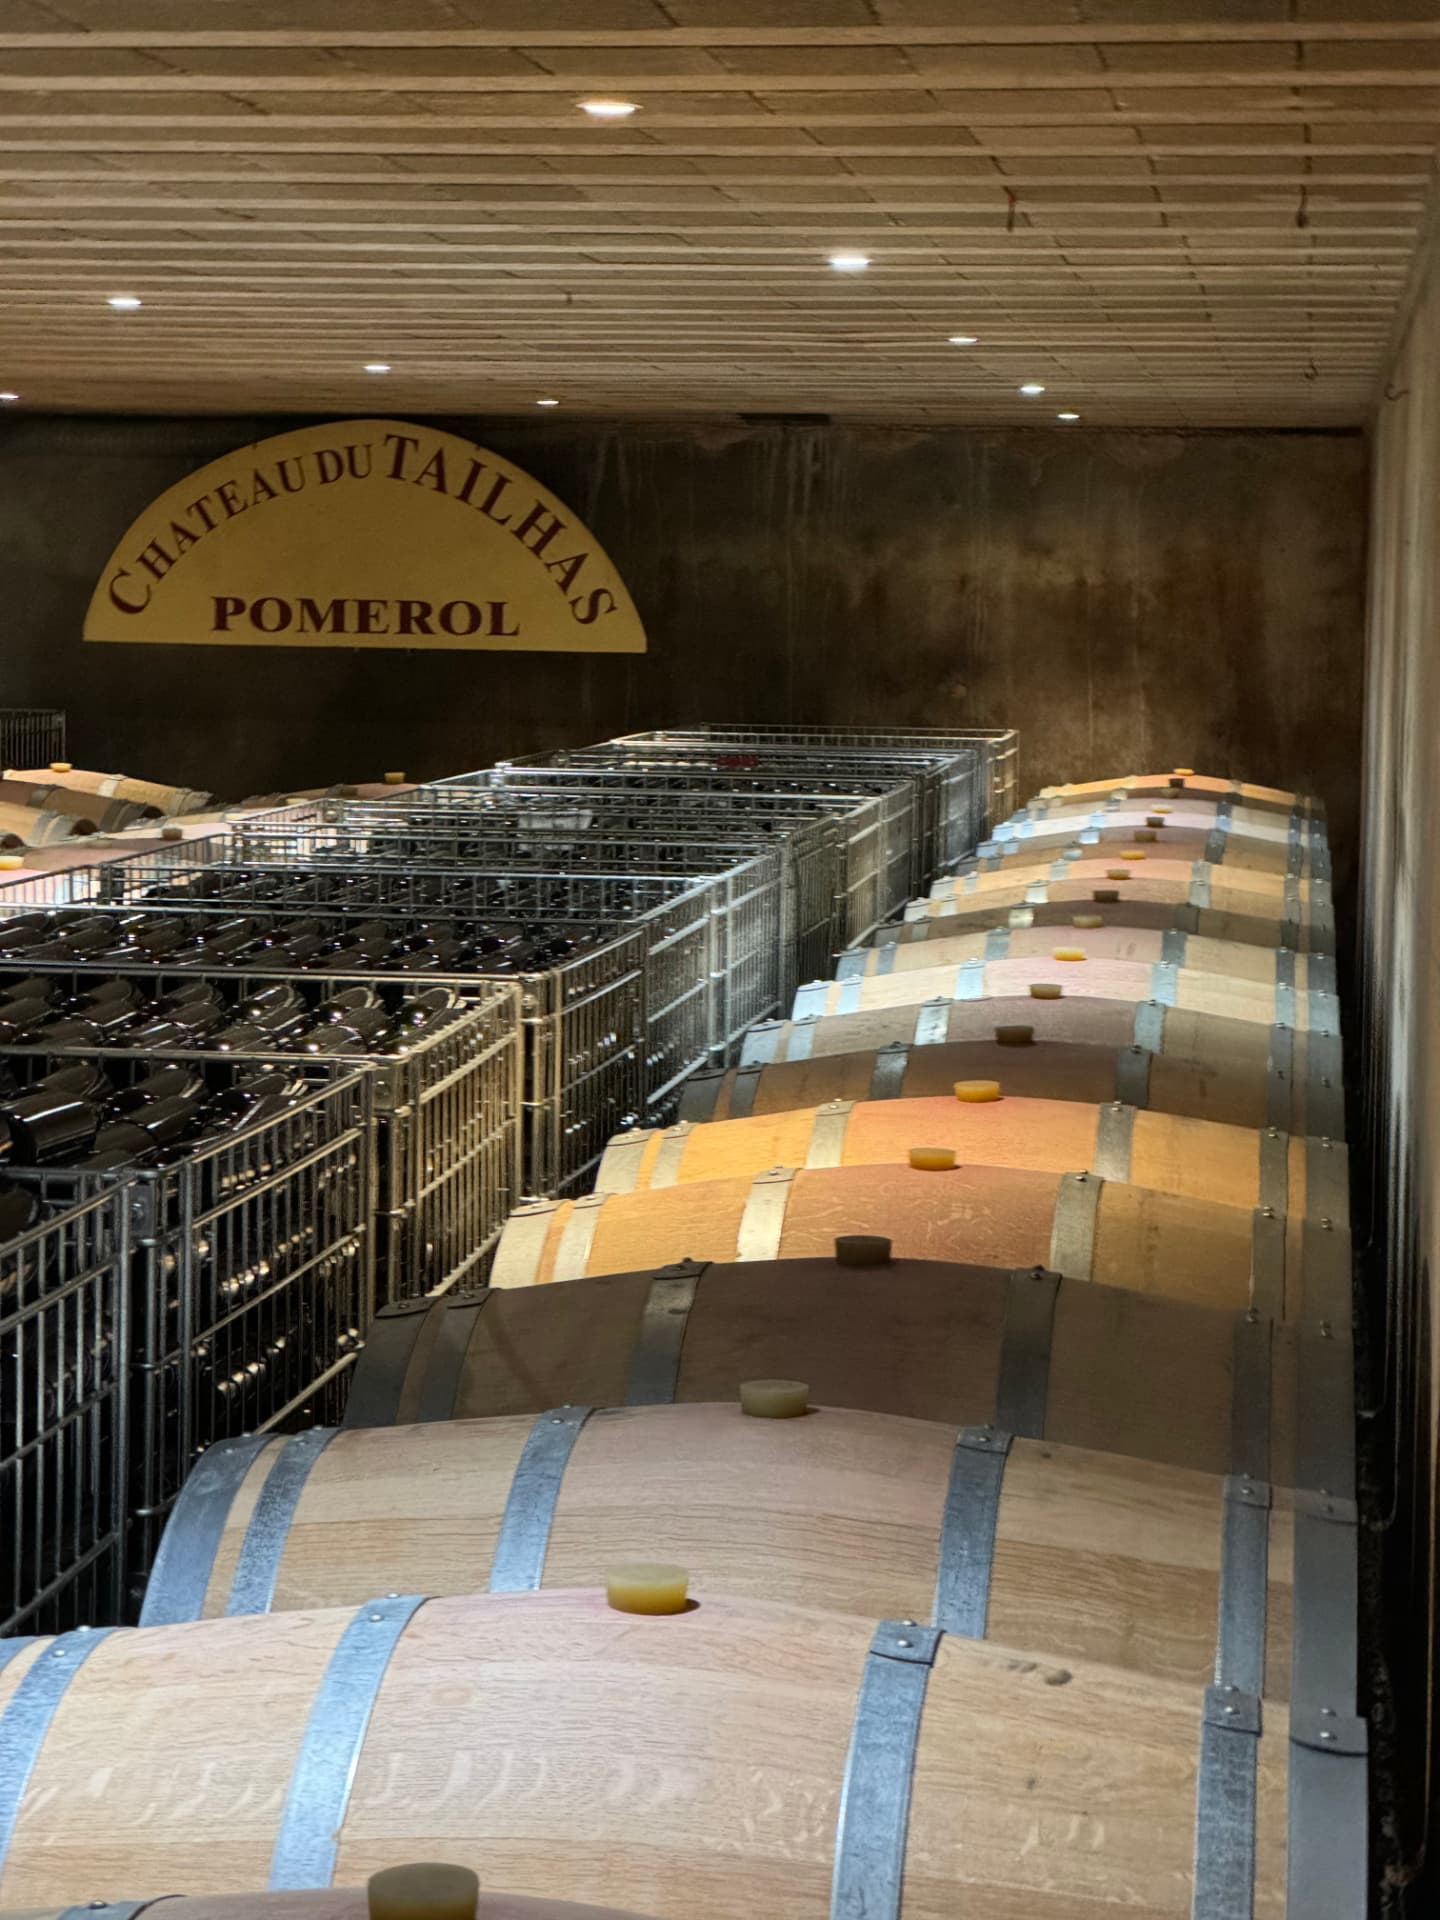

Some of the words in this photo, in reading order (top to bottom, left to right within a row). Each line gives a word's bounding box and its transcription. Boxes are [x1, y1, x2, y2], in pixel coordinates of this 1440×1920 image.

[108, 456, 306, 615] CHATEAU
[313, 443, 375, 486] DU
[383, 433, 618, 625] TAILHAS
[211, 596, 521, 637] POMEROL
